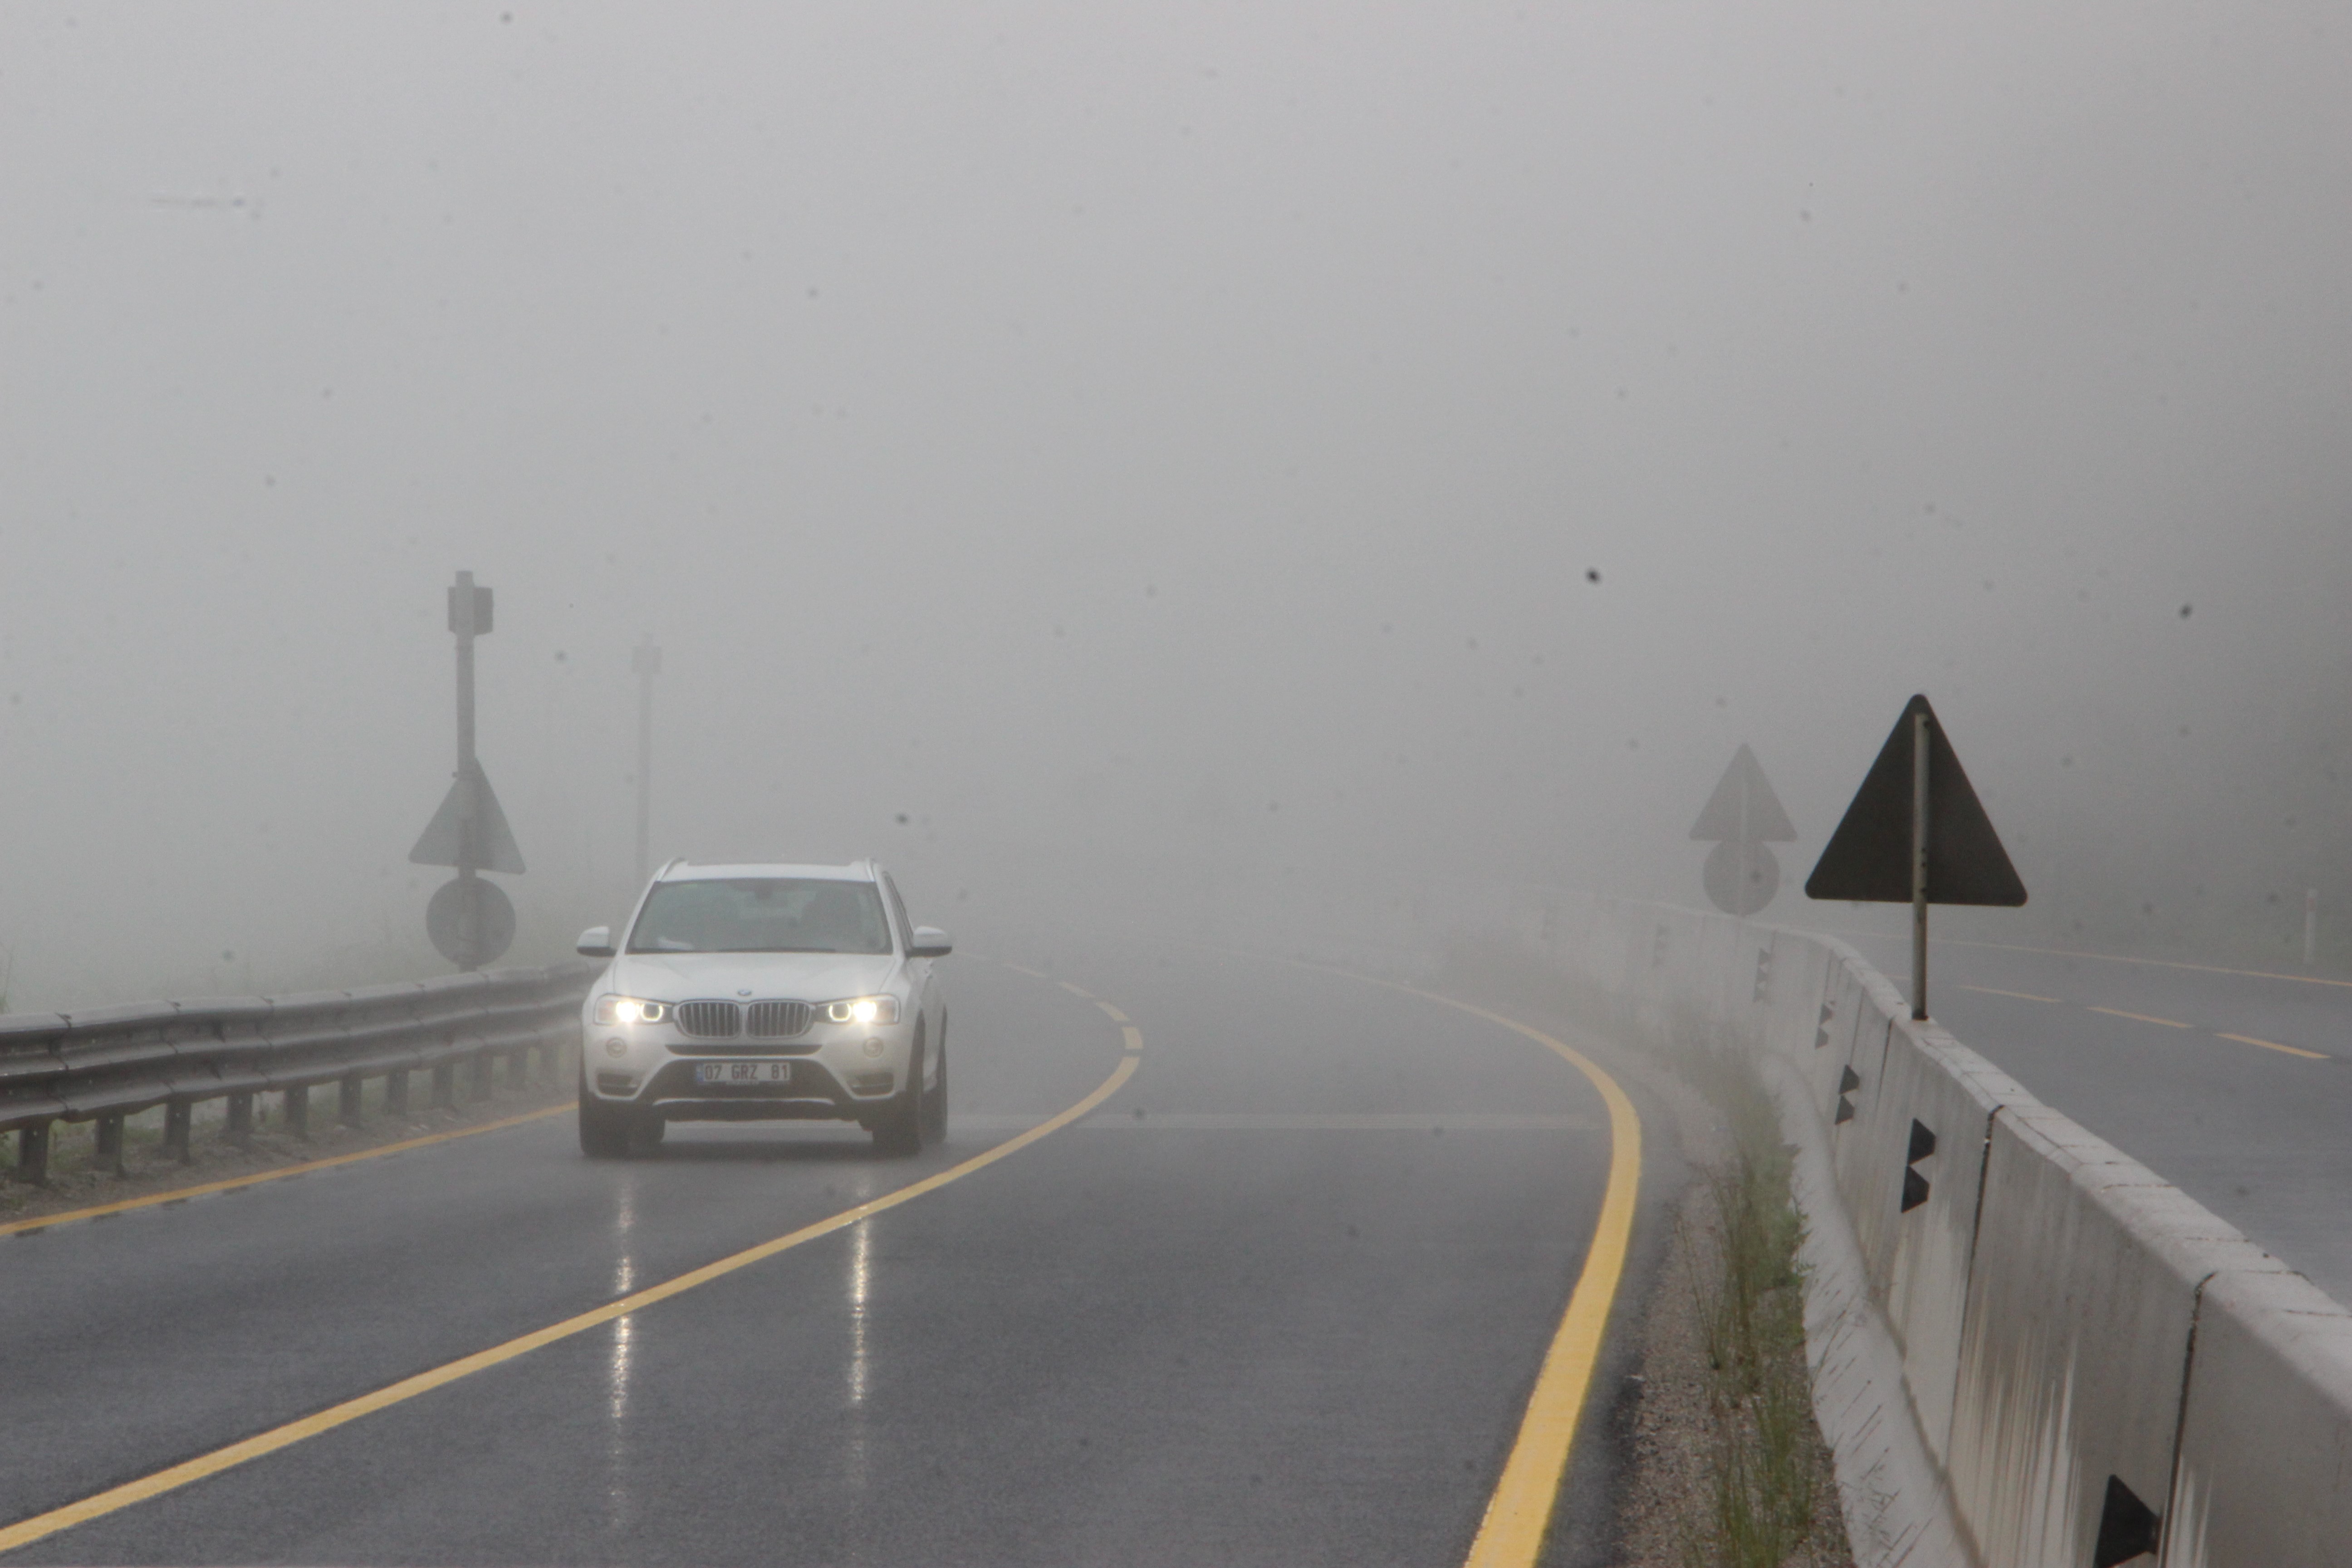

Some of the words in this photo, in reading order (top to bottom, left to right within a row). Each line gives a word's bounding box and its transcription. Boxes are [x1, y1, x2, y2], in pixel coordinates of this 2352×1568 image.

[705, 1064, 722, 1079] 07
[731, 1064, 758, 1080] GRZ
[772, 1064, 787, 1079] 81
